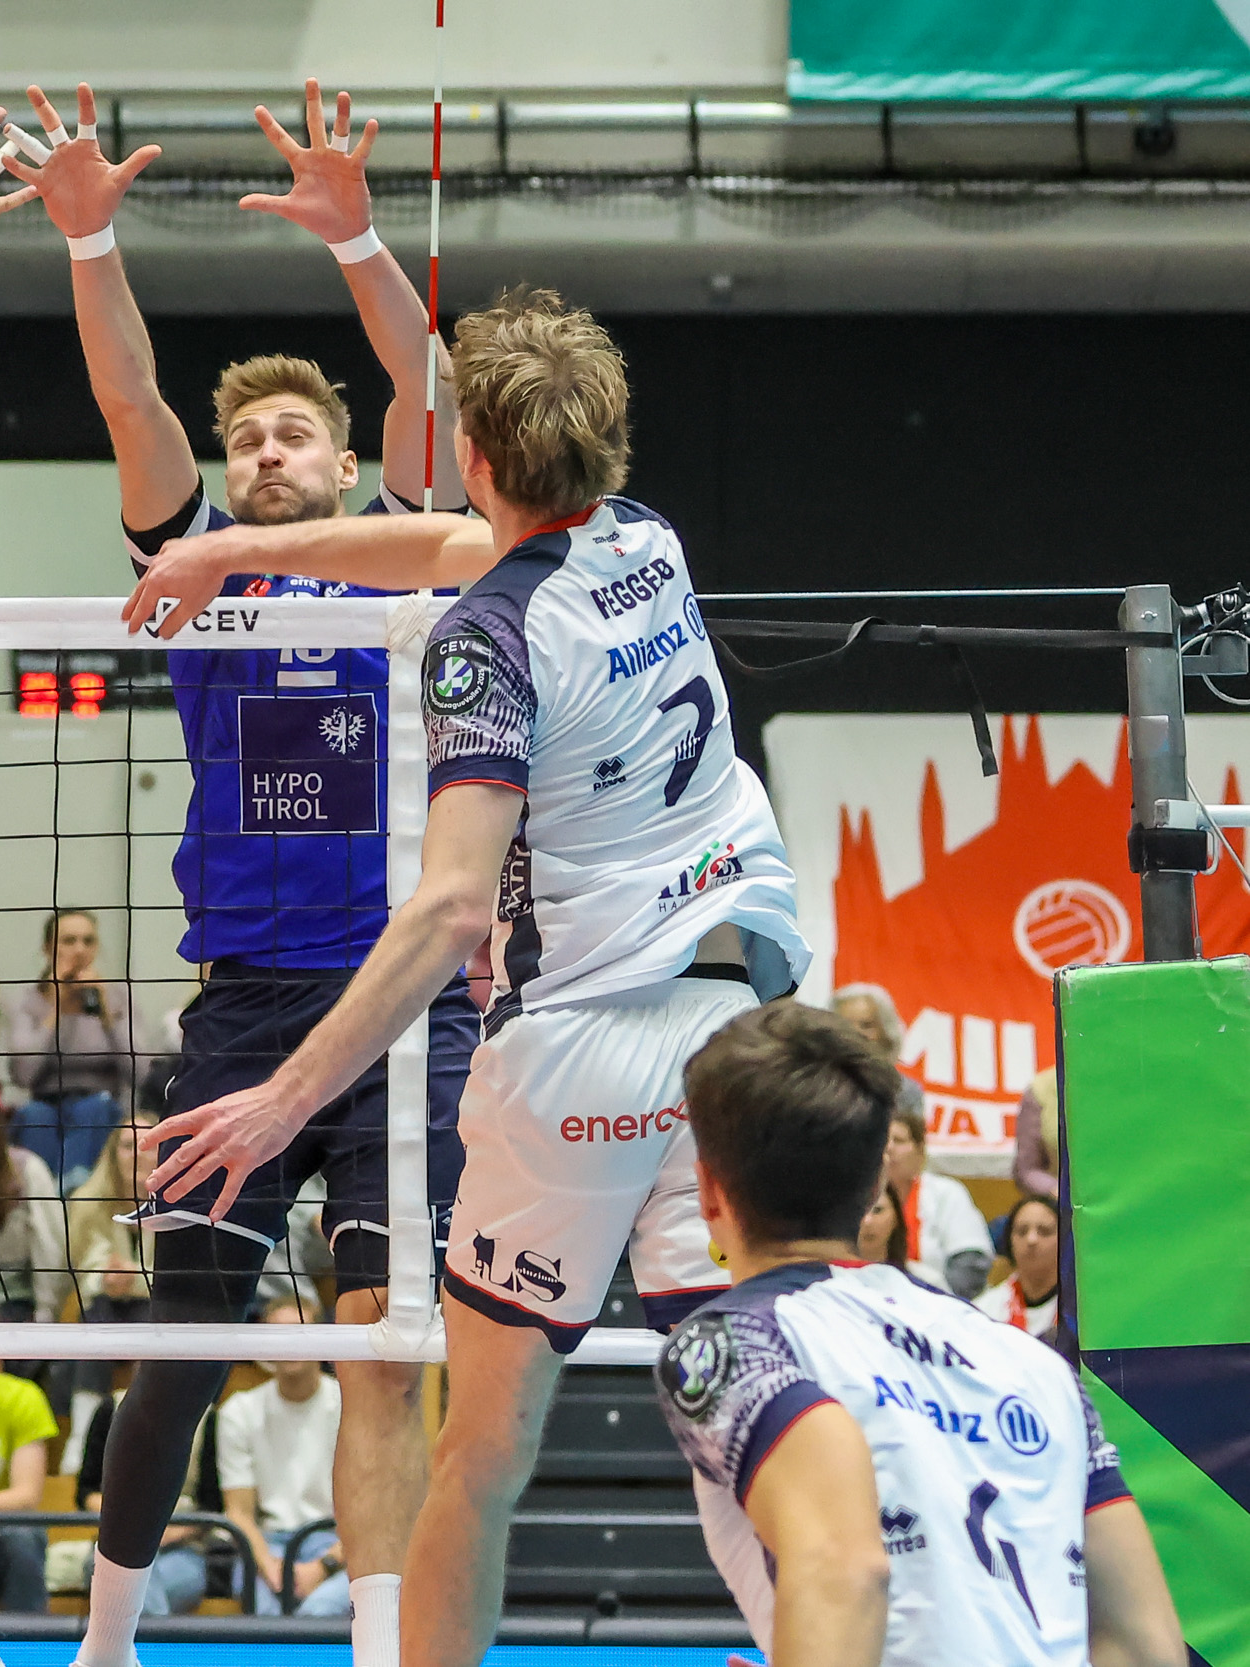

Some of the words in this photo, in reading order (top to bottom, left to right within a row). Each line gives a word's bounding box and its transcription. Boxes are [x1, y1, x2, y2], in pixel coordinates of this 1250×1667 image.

[191, 609, 260, 632] CEV
[439, 640, 469, 655] CEV
[606, 621, 689, 684] Allianz
[477, 668, 485, 686] 2025
[657, 675, 715, 807] 7
[253, 772, 323, 795] HYPO
[252, 797, 328, 820] TIROL
[883, 1533, 926, 1555] rrea
